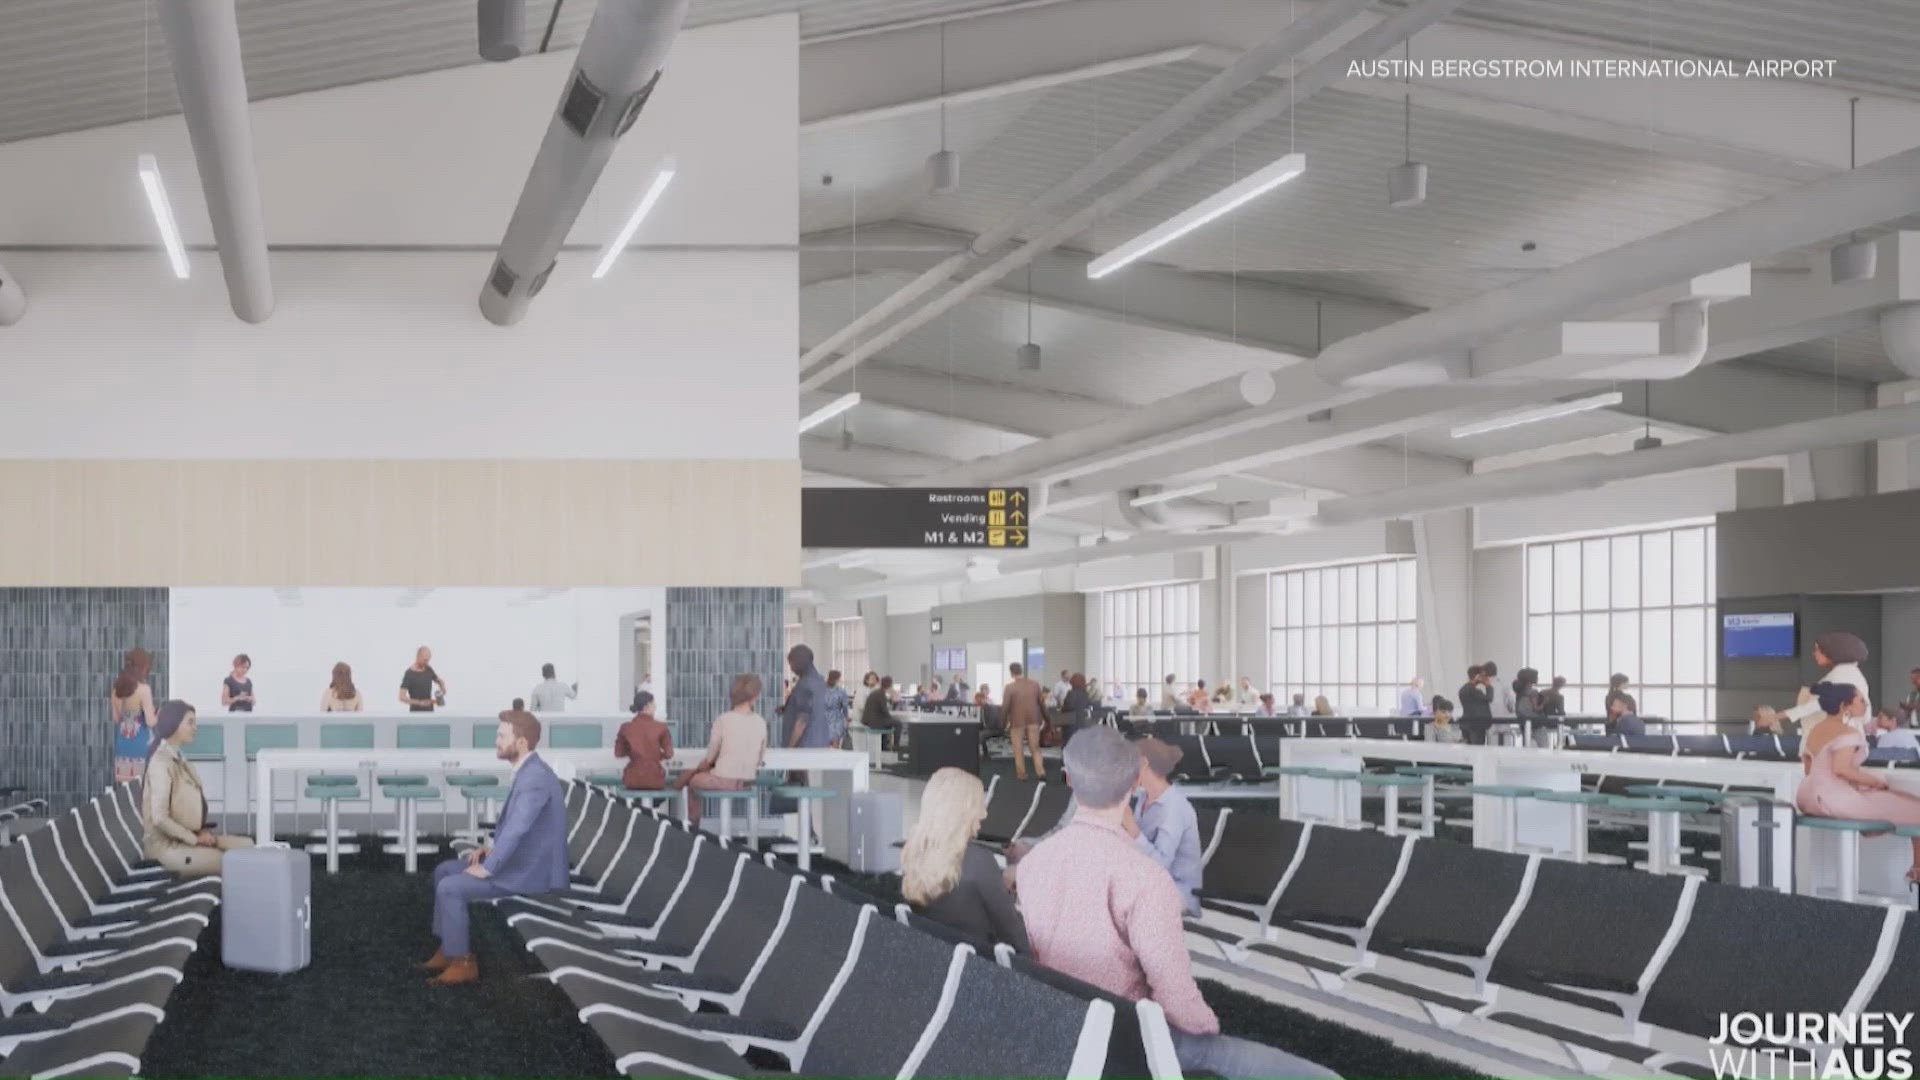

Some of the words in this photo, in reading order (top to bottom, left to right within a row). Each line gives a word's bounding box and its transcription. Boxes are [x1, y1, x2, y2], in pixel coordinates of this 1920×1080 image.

[928, 493, 986, 503] Restrooms
[941, 513, 986, 524] Vending
[924, 531, 944, 544] M1
[947, 531, 959, 544] &
[963, 531, 986, 544] M2
